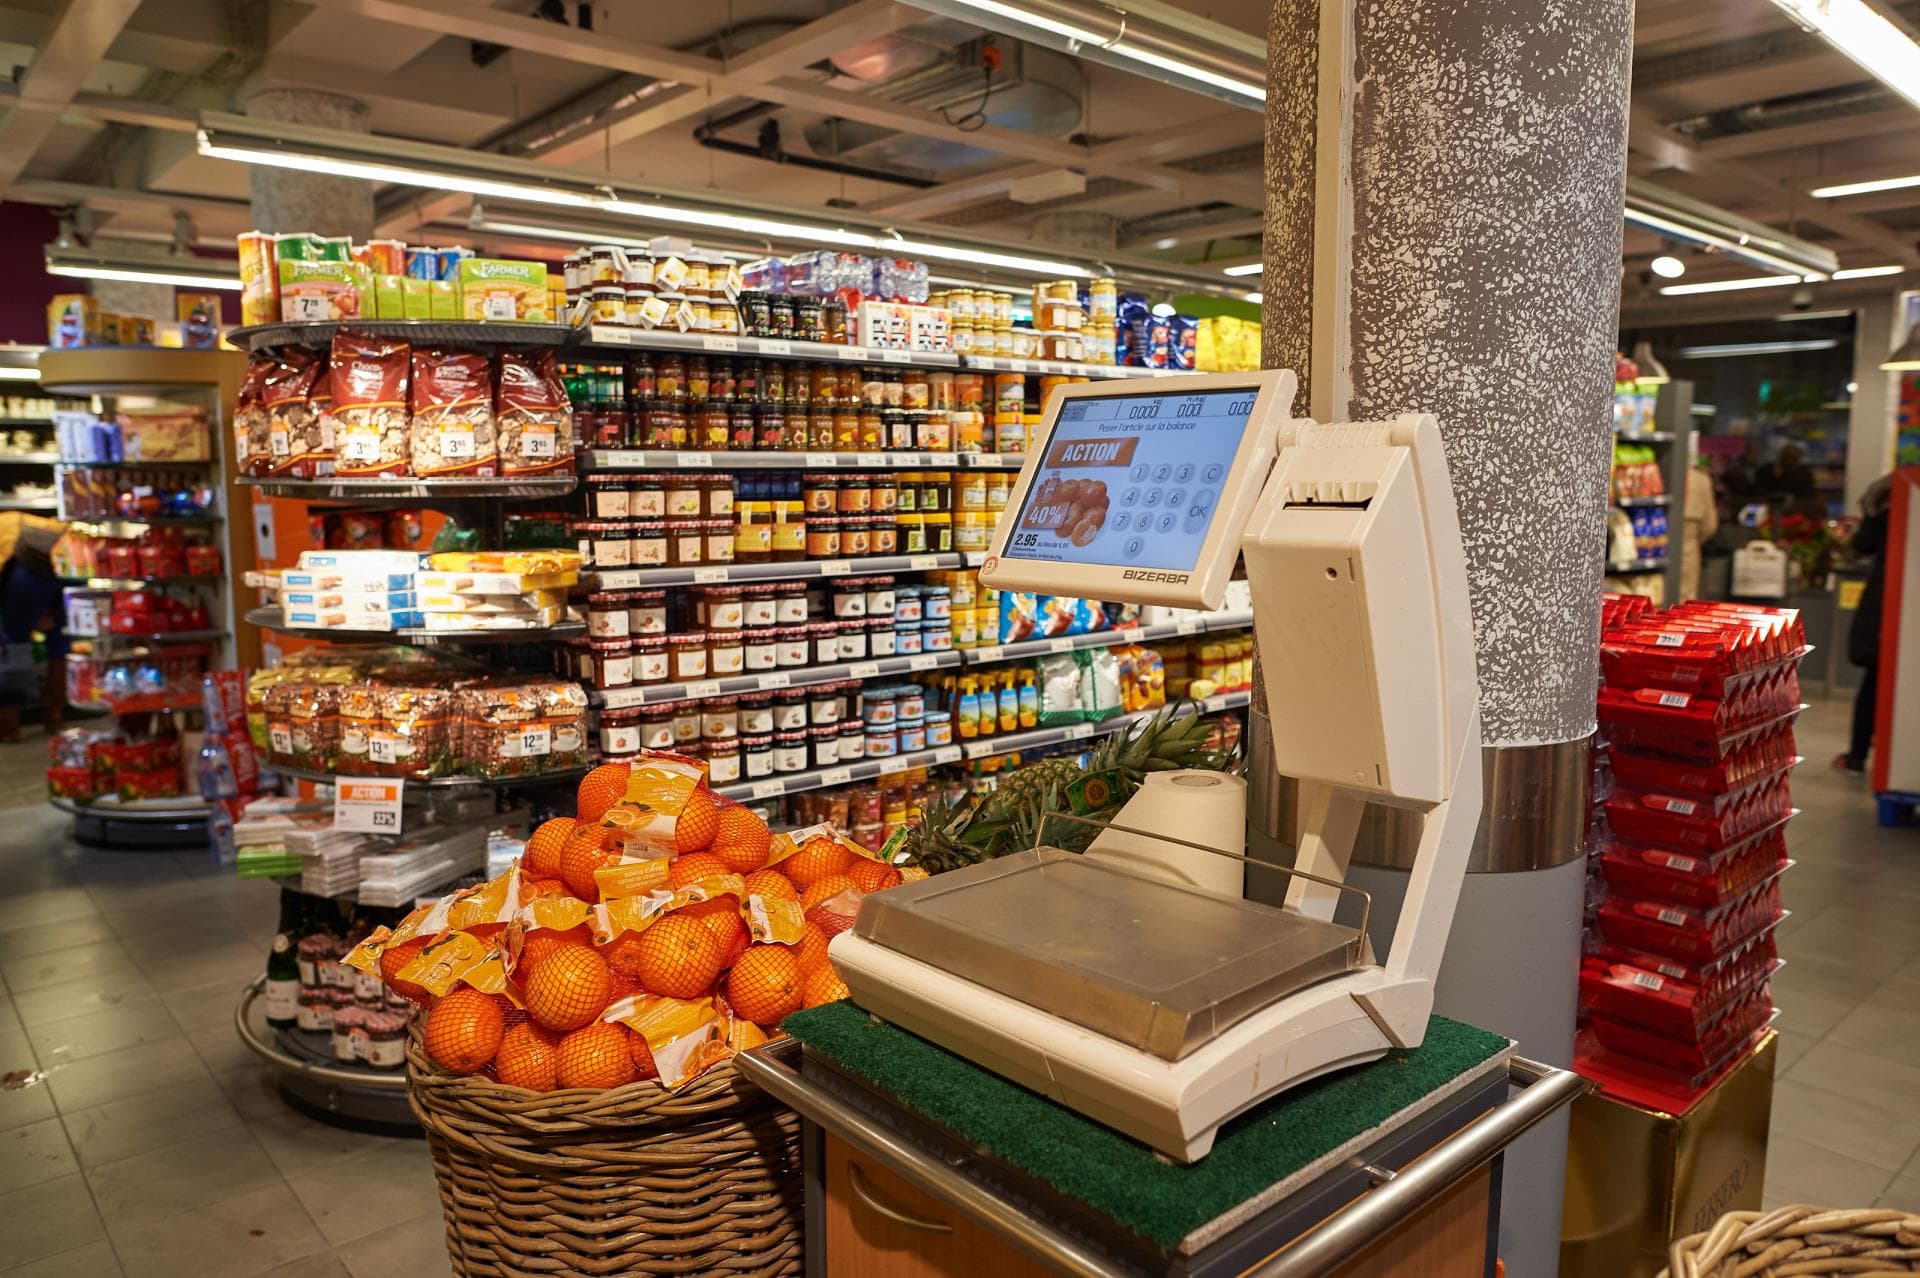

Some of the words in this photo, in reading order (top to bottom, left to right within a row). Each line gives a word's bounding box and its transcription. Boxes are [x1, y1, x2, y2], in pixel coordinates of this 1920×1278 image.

[294, 261, 344, 277] FARMER
[480, 262, 530, 278] FARMER
[1098, 424, 1118, 432] Poser
[1166, 422, 1196, 430] balance
[1061, 442, 1120, 462] ACTION
[1136, 468, 1142, 479] 1
[1158, 468, 1166, 479] 2
[1180, 468, 1188, 479] 3
[1207, 468, 1217, 480] C
[1127, 492, 1134, 502] 4
[1148, 492, 1158, 504] 5
[1171, 493, 1179, 504] 6
[1029, 505, 1061, 524] 40%
[1189, 505, 1207, 518] OK
[1117, 515, 1125, 527] 7
[1139, 516, 1148, 528] 8
[1163, 517, 1170, 528] 9
[1014, 533, 1038, 546] 2.95
[1130, 541, 1138, 553] 0
[1123, 570, 1189, 585] BIZERBA
[352, 785, 386, 800] ACTION
[374, 812, 395, 825] 33%
